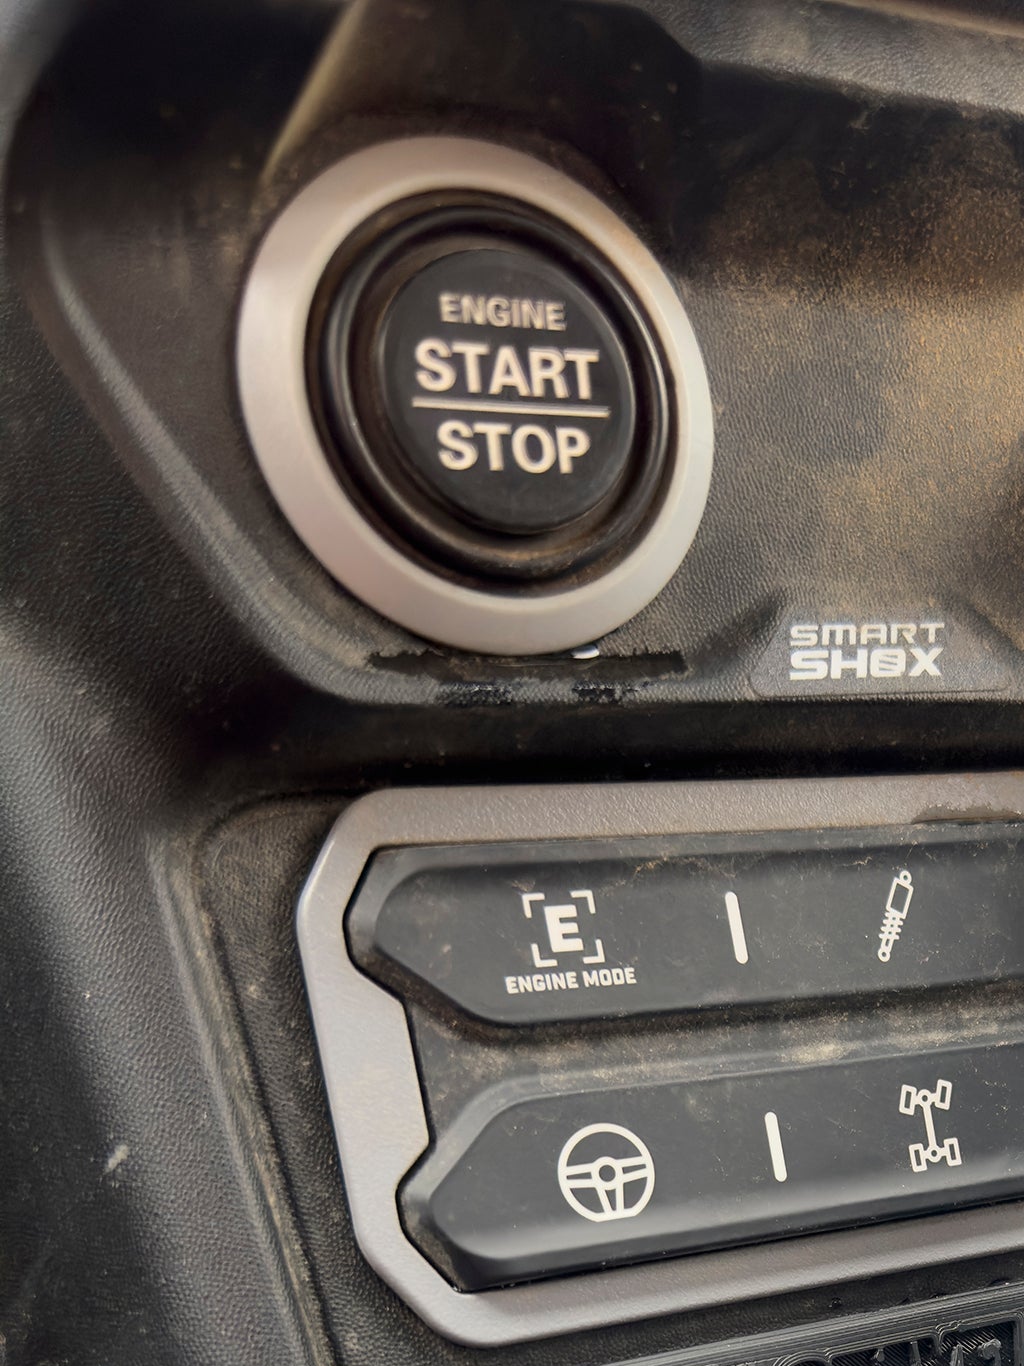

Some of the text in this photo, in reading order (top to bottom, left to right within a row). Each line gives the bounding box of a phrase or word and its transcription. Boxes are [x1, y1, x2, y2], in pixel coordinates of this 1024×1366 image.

[439, 292, 567, 331] ENGINE
[415, 338, 599, 400] START
[437, 420, 590, 474] STOP
[790, 622, 945, 647] SMART
[789, 647, 944, 680] SHOX
[544, 904, 584, 953] E
[505, 967, 637, 994] ENGINE MODE
